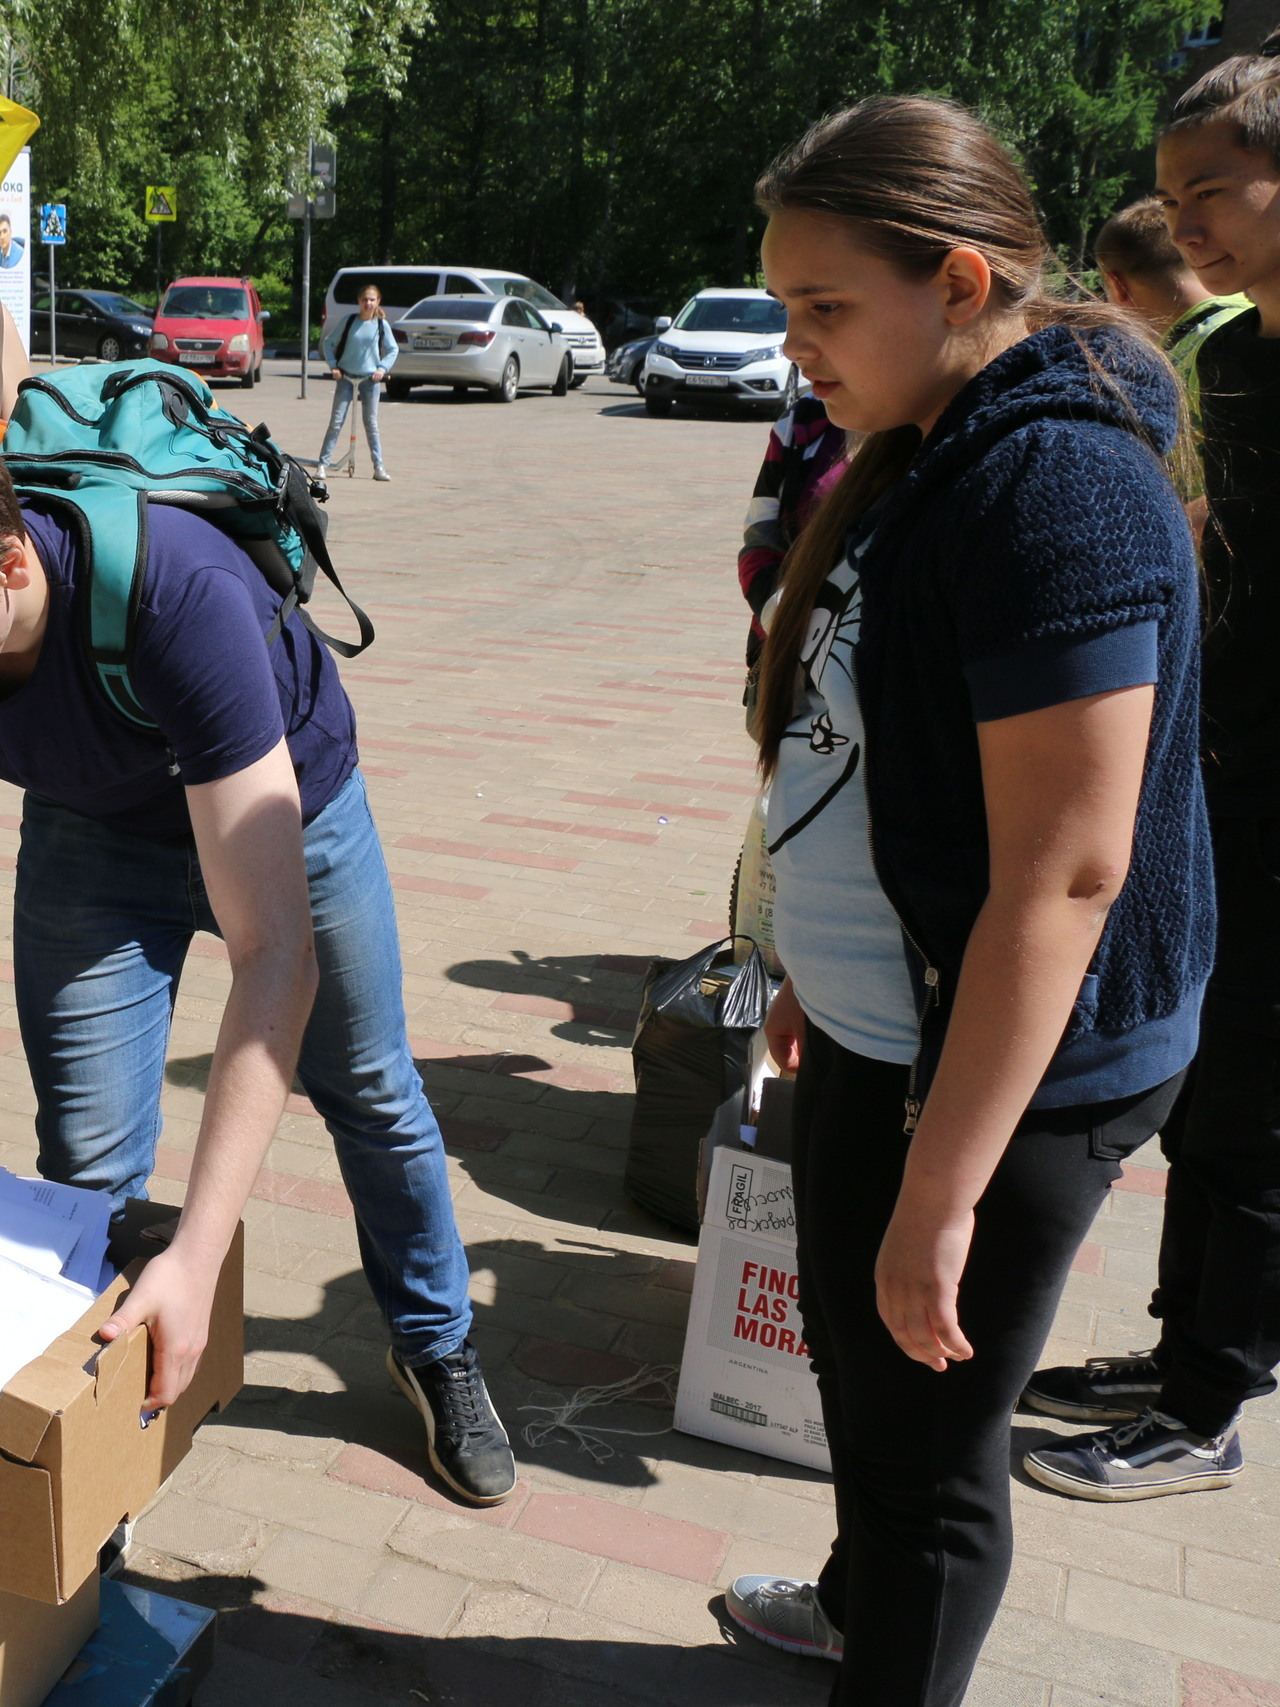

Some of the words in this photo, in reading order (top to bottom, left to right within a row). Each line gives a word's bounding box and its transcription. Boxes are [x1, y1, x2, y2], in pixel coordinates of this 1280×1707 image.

[765, 908, 774, 919] (8
[742, 1260, 801, 1300] FINC
[737, 1287, 788, 1323] LAS
[733, 1314, 814, 1359] MORA
[728, 1359, 769, 1375] ARGENTINA
[713, 1391, 740, 1406] MALBEC
[745, 1401, 762, 1412] 2017
